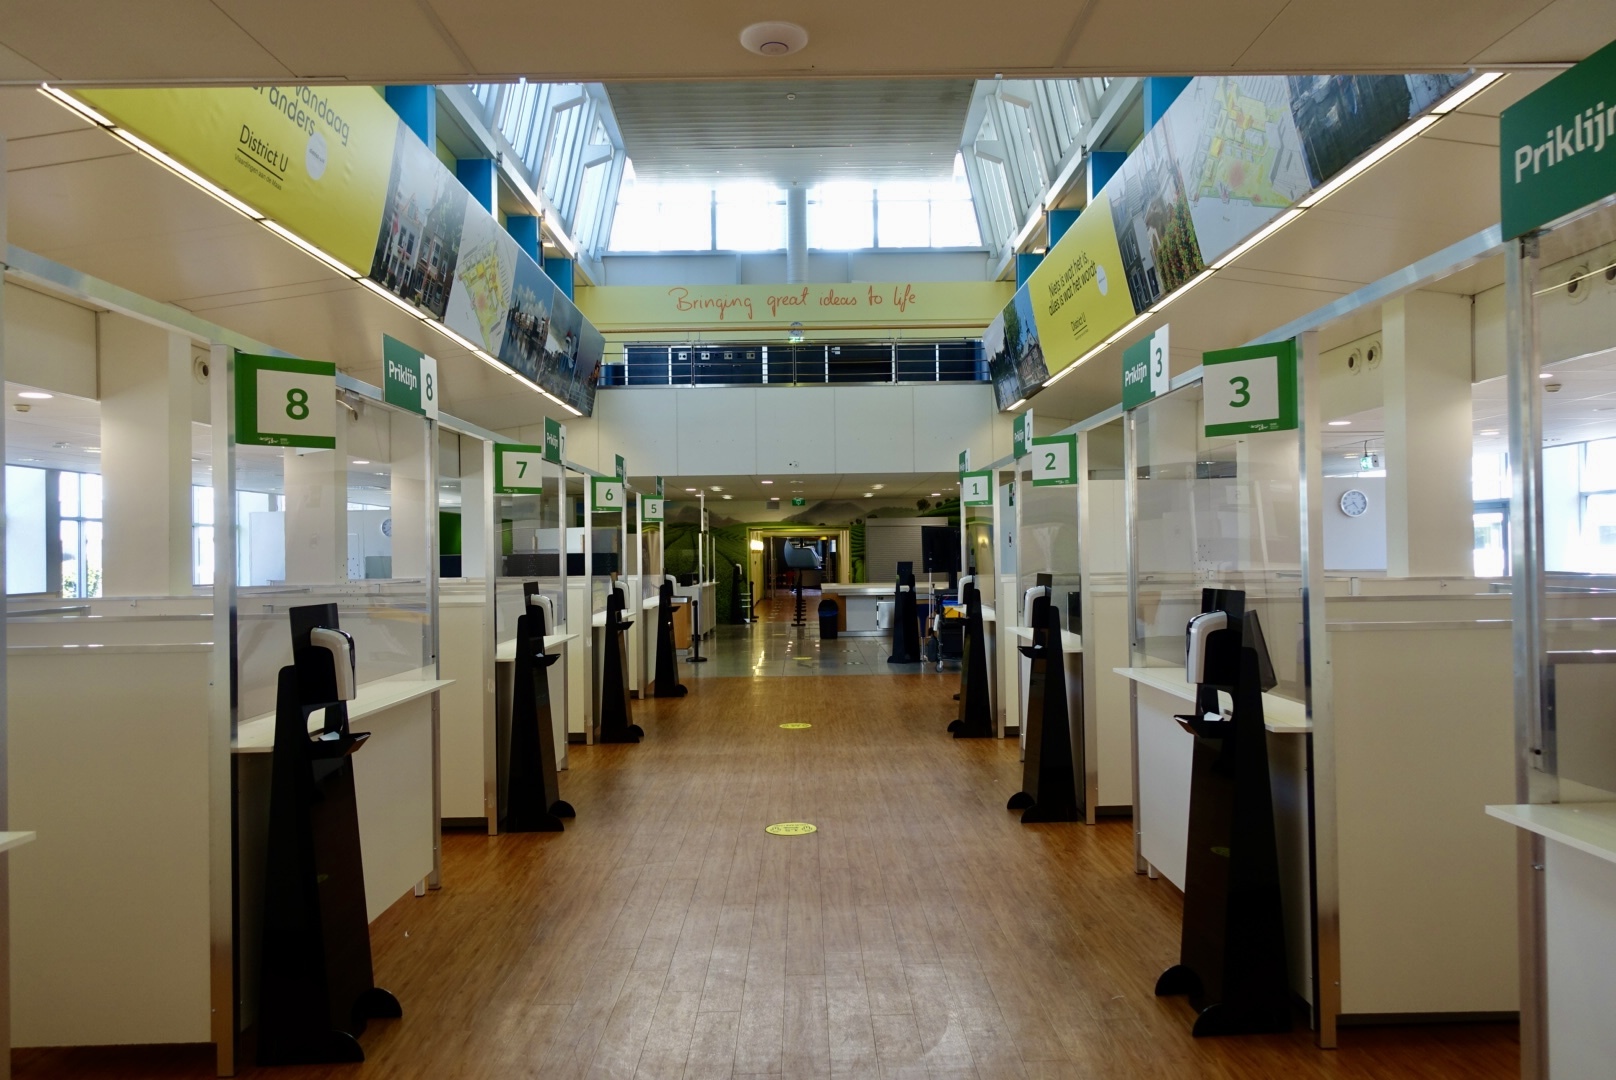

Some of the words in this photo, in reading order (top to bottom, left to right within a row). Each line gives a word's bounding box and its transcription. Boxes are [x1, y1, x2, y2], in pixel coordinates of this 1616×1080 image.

[269, 85, 316, 137] anders
[239, 124, 278, 167] District
[279, 153, 289, 173] U
[668, 287, 753, 320] Bringing
[766, 286, 810, 317] great
[819, 289, 858, 306] ideas
[867, 285, 883, 306] to
[893, 284, 917, 312] life
[388, 360, 418, 392] Priklijn
[425, 373, 434, 402] 8
[1124, 362, 1148, 388] Priklijn
[1155, 347, 1163, 378] 3
[285, 388, 310, 421] 8
[1228, 376, 1251, 408] 3
[516, 461, 528, 479] 7
[1045, 452, 1056, 471] 2
[605, 488, 614, 501] 6
[972, 483, 980, 495] 1
[651, 503, 657, 514] 5
